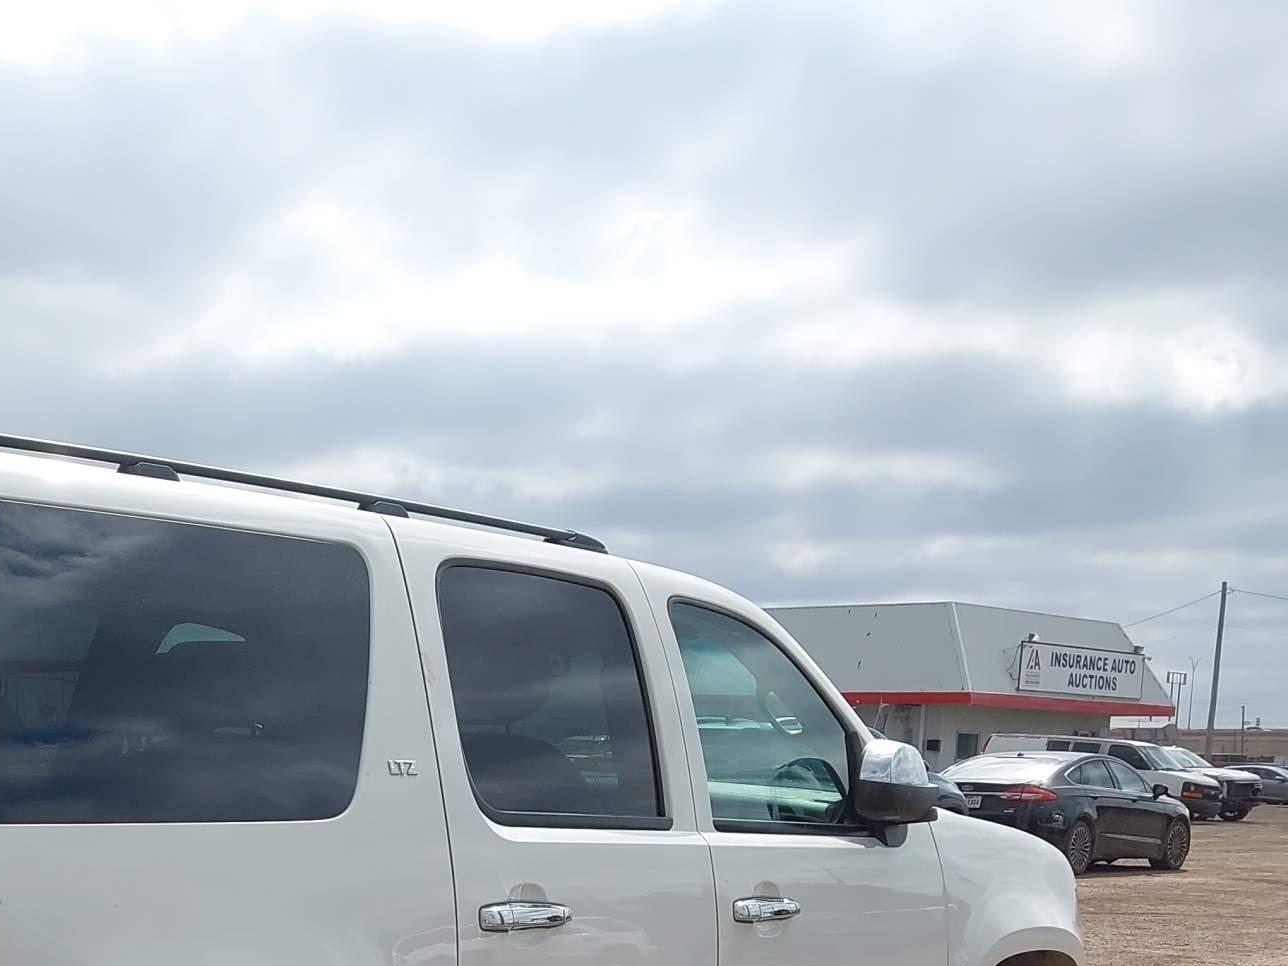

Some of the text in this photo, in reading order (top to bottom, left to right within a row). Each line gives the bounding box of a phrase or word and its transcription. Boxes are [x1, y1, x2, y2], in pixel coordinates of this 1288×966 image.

[1050, 651, 1137, 674] INSURANCE AUTO
[1067, 672, 1117, 691] AUCTIONS
[387, 759, 418, 776] LTZ
